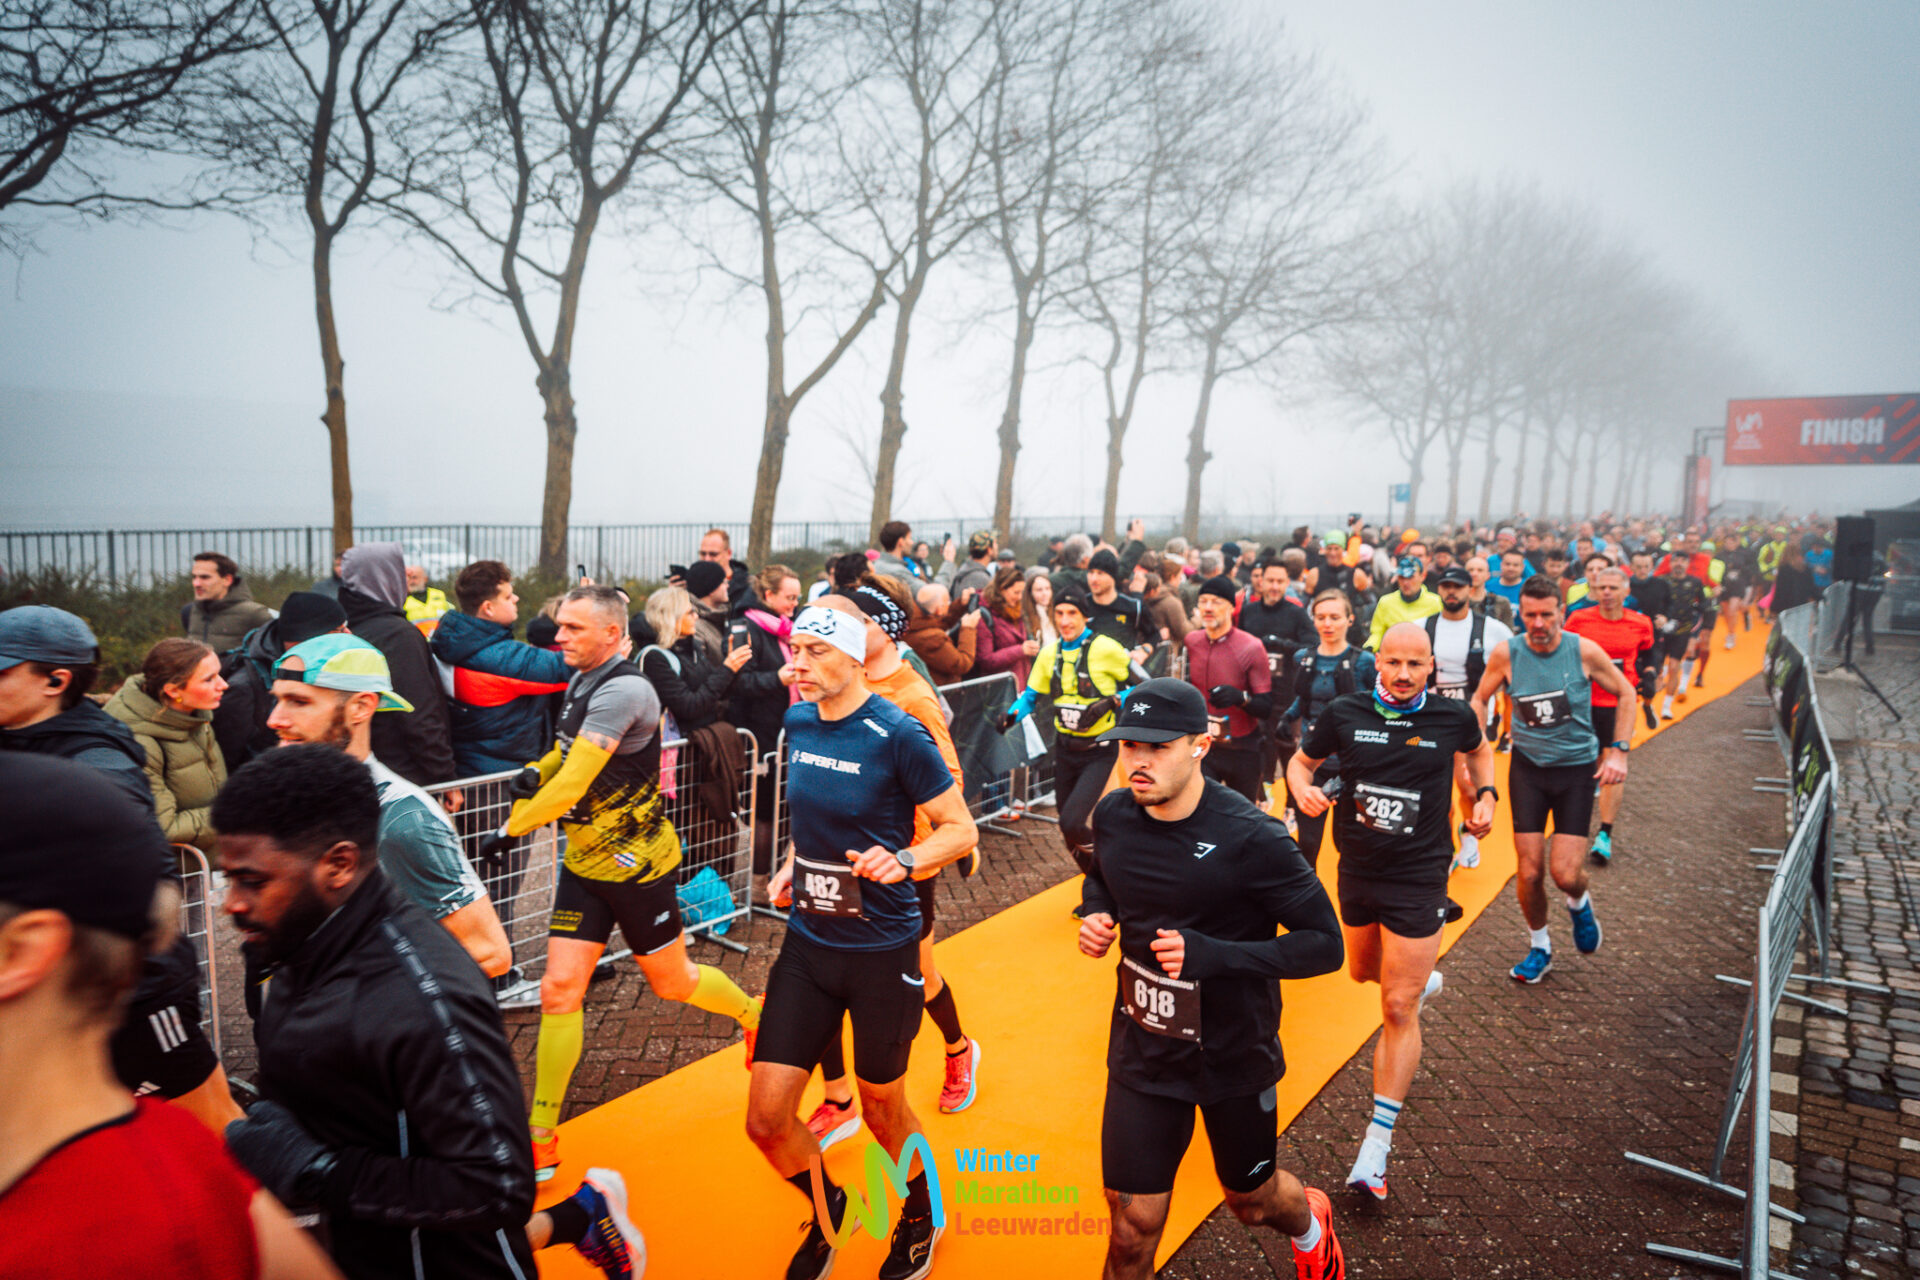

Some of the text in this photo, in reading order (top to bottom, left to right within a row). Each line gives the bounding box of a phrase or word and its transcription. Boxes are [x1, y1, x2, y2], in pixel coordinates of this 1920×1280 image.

[1800, 416, 1886, 446] FINISH
[1365, 796, 1404, 822] 262
[805, 872, 843, 901] 482
[1134, 979, 1176, 1018] 618
